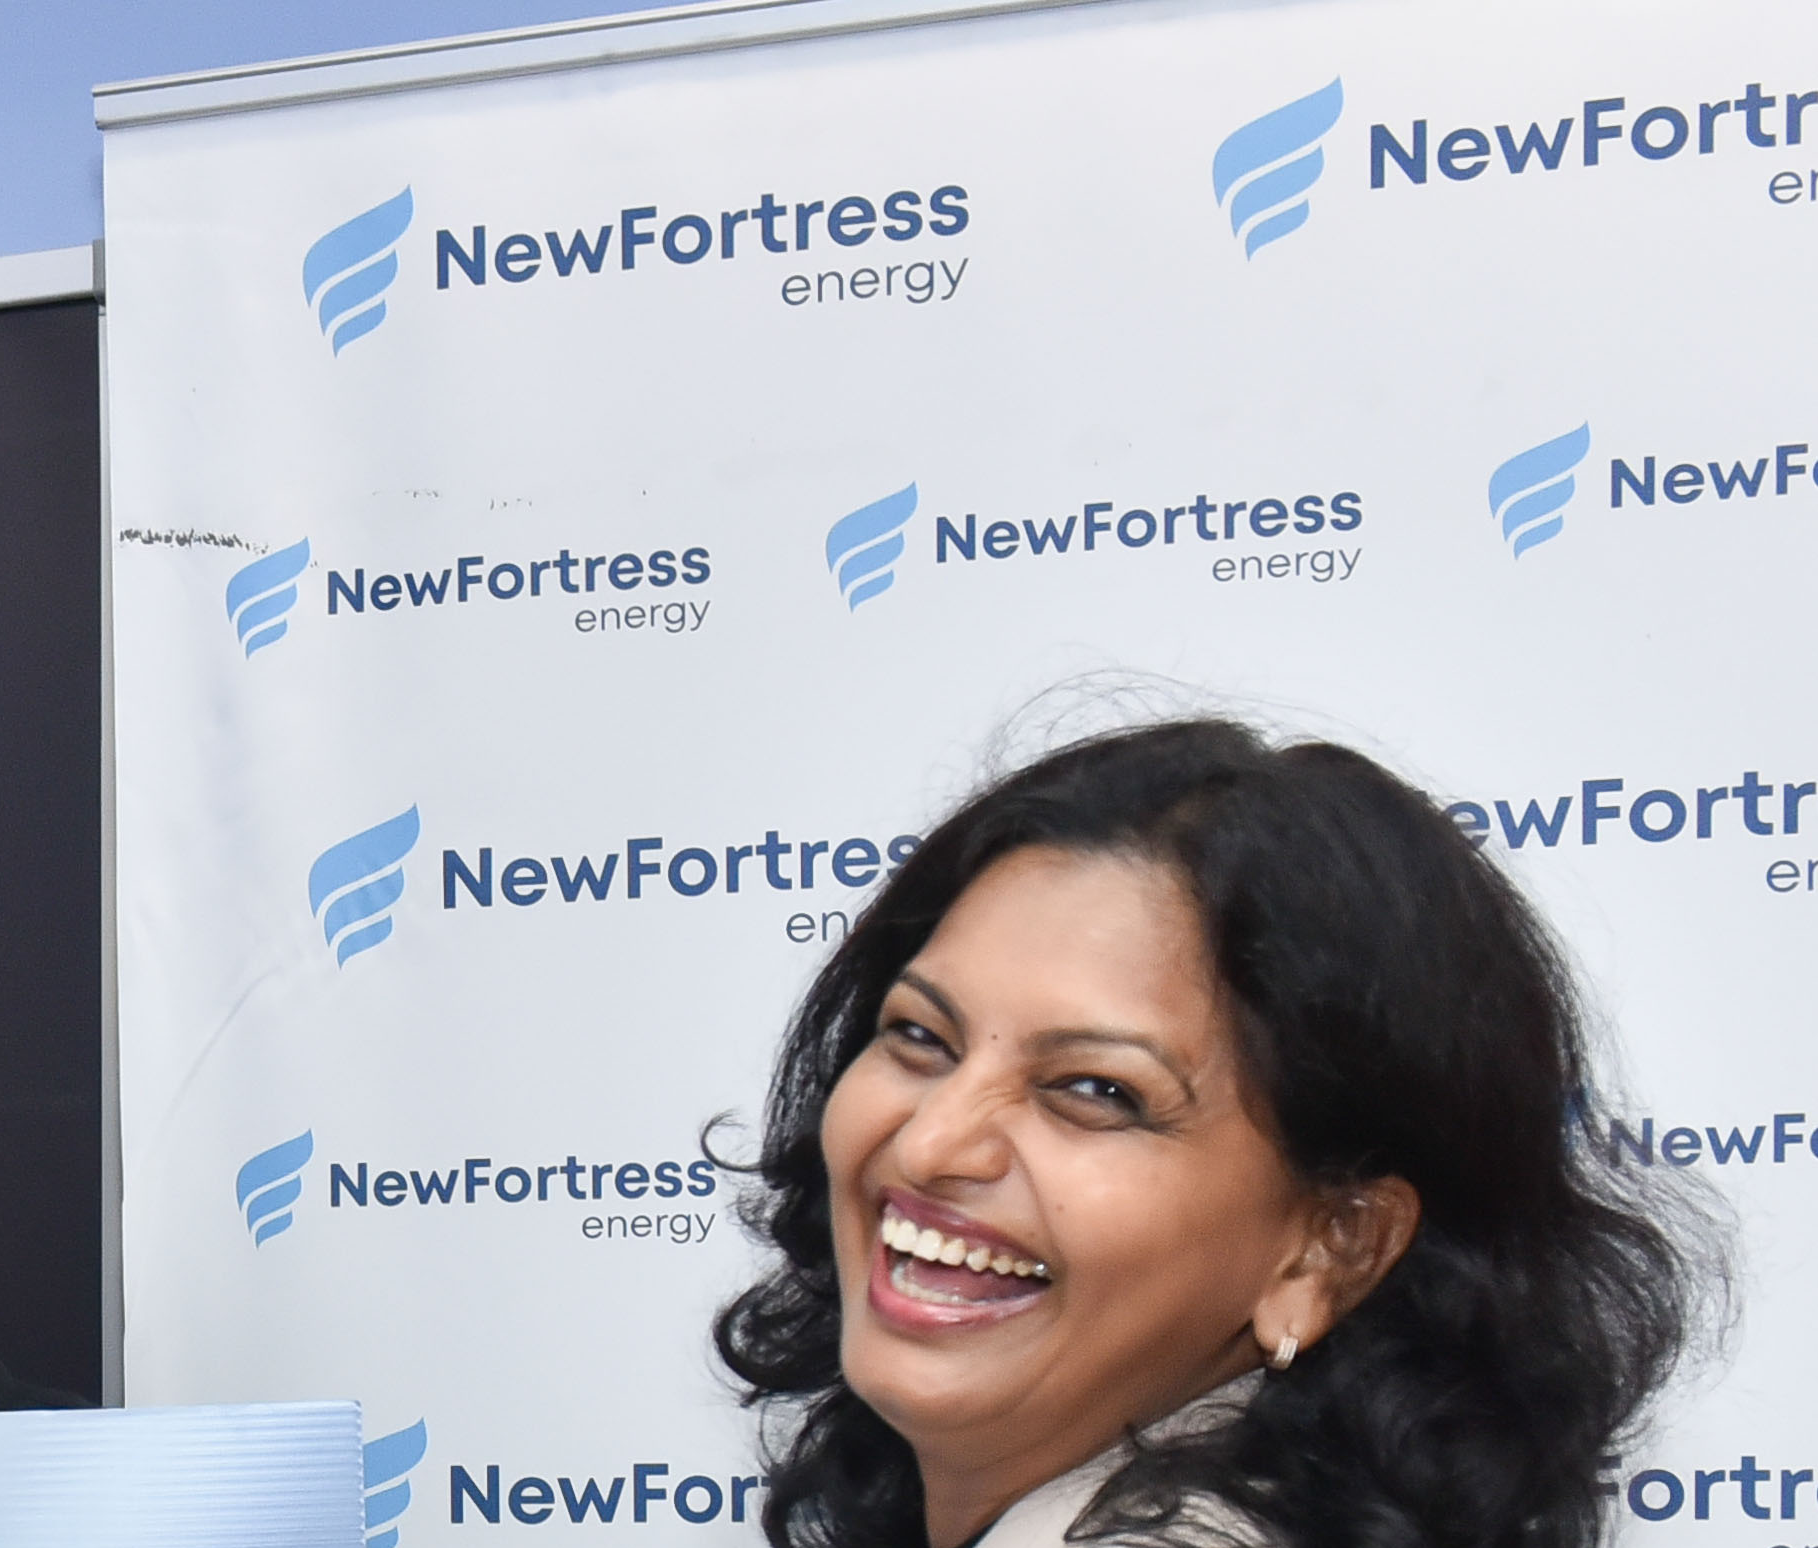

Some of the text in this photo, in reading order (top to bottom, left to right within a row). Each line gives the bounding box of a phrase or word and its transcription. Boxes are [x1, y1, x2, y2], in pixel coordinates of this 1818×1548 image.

[1369, 84, 1818, 190] NewFortr
[435, 186, 970, 290] NewFortress
[781, 257, 969, 307] energy
[936, 492, 1363, 561] NewFortress
[325, 546, 712, 616] NewFortress
[1212, 548, 1362, 582] energy
[574, 598, 710, 634] energy
[329, 1155, 717, 1208] NewFortress
[581, 1211, 717, 1243] energy
[450, 1464, 772, 1524] NewFor
